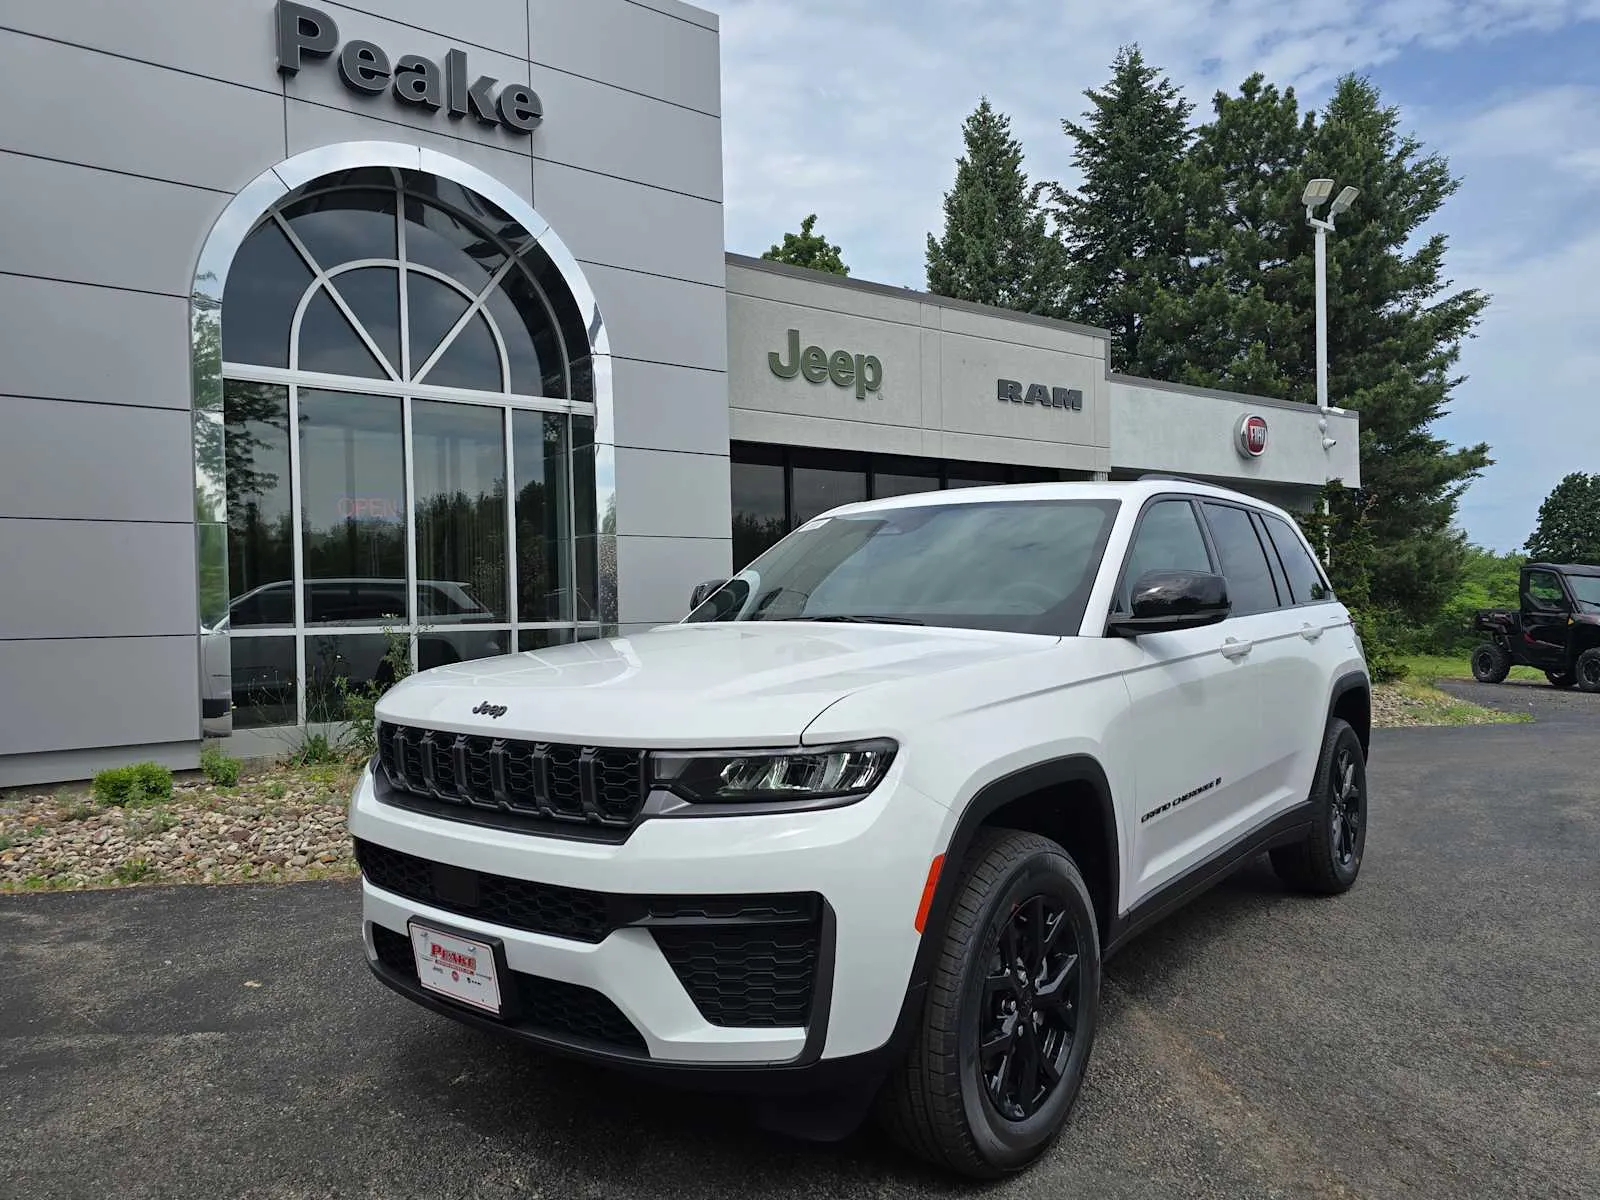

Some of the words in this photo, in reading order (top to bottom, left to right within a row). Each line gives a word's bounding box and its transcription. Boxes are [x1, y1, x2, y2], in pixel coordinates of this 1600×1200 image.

[274, 0, 544, 135] Peake
[768, 329, 883, 399] Jeep
[997, 378, 1083, 411] RAM
[1249, 425, 1266, 445] FIAT
[336, 497, 402, 518] OPEN
[472, 700, 508, 719] Jeep
